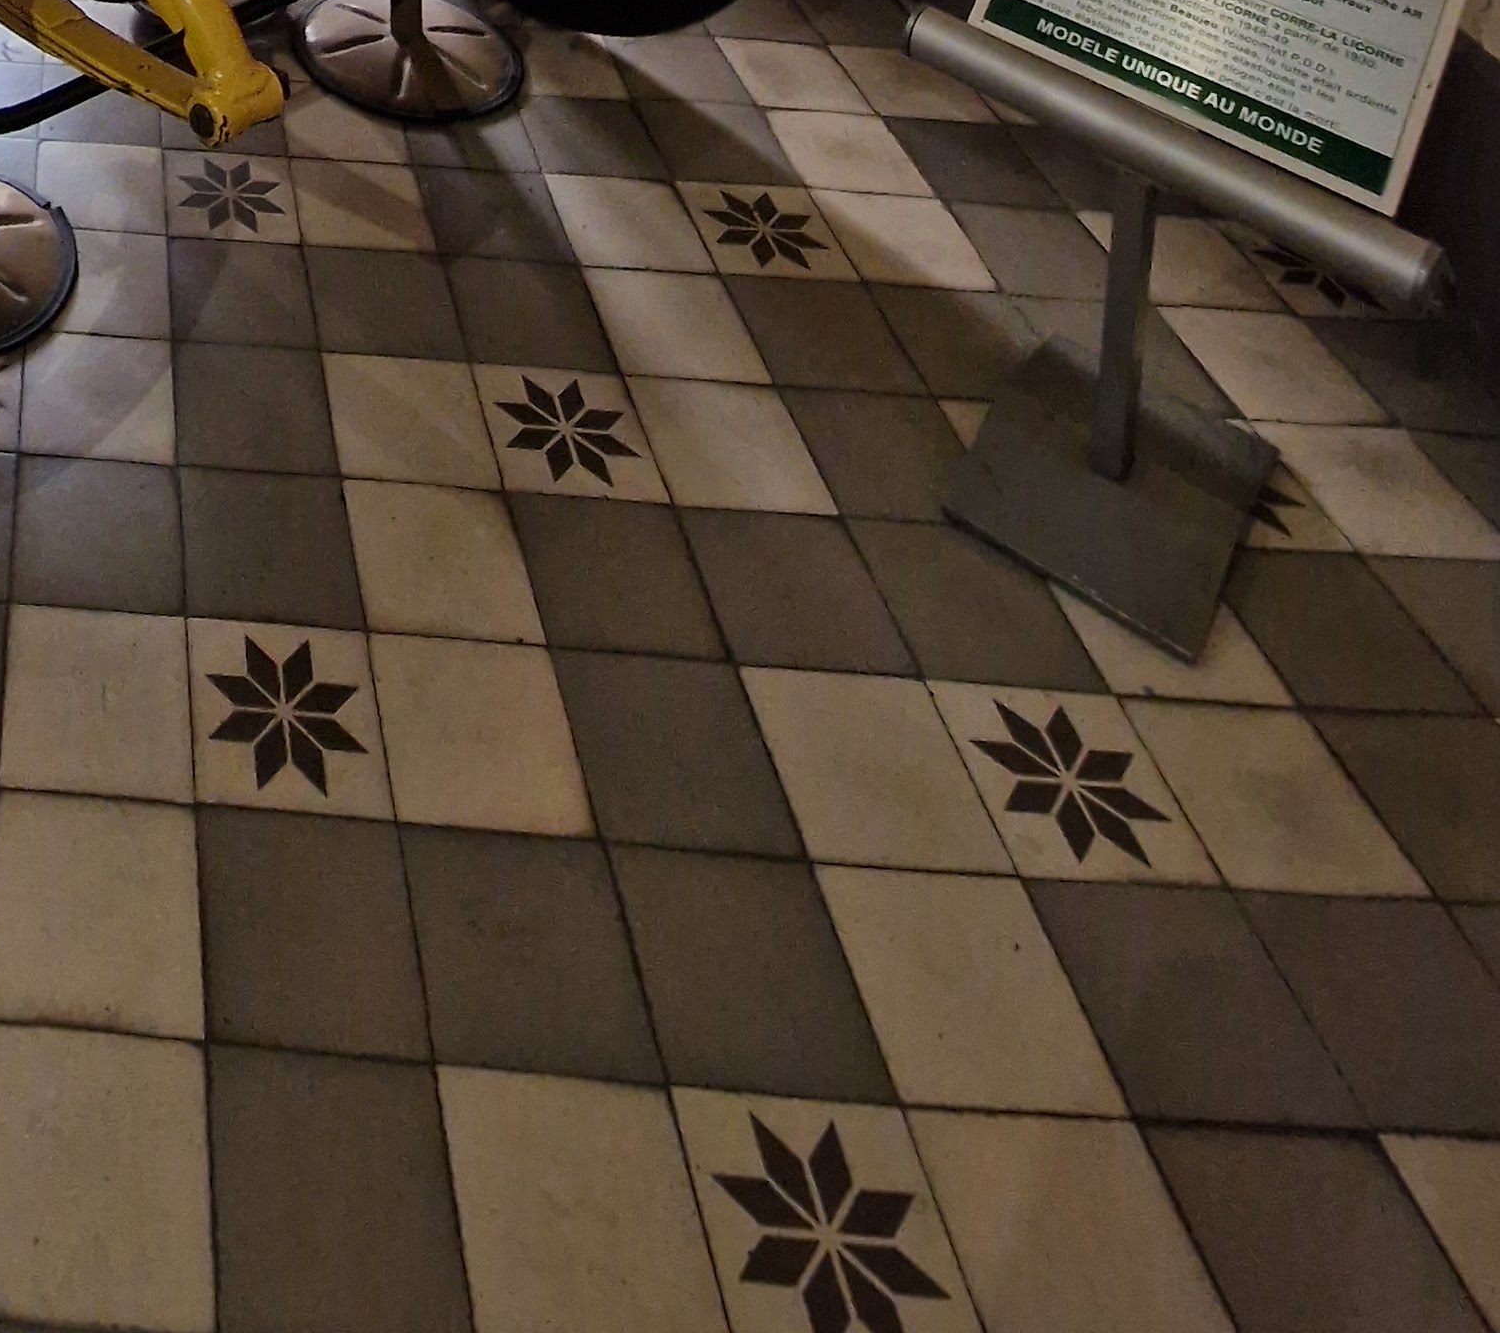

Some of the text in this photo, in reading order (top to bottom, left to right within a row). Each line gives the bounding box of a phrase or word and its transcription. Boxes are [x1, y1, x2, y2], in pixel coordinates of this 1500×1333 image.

[1035, 18, 1325, 154] MODELE UNIQUE AU MONDE
